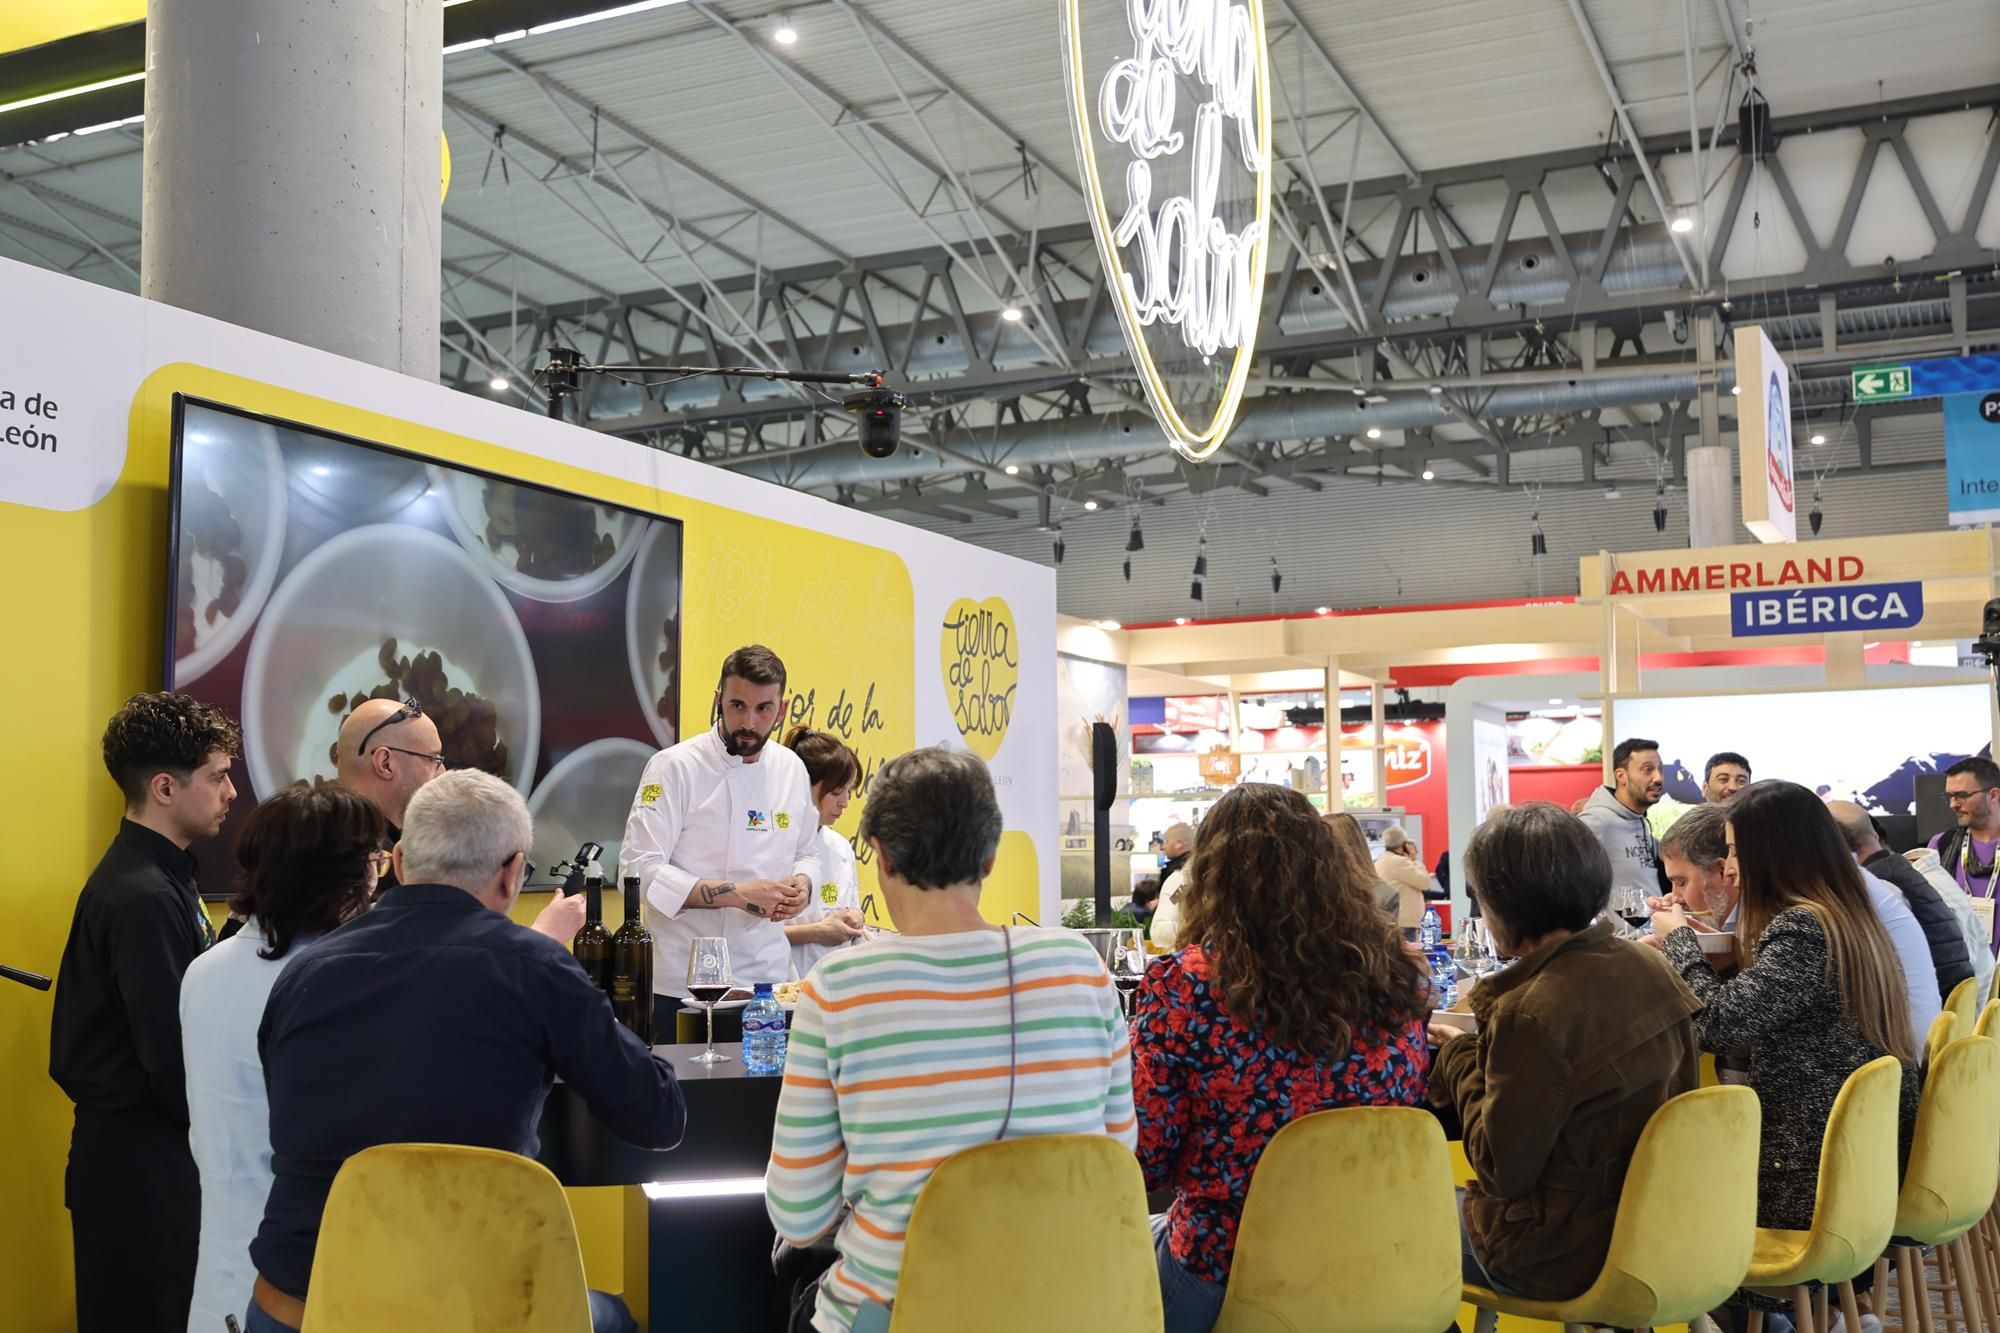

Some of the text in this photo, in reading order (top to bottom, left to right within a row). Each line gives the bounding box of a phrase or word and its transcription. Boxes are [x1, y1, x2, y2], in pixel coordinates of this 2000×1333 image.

[25, 392, 58, 420] de
[1985, 401, 2000, 417] P
[0, 423, 57, 452] eón
[1960, 478, 2000, 495] Inte
[1609, 556, 1864, 595] AMMERLAND
[1745, 591, 1909, 626] IBÉRICA
[943, 608, 1017, 668] tierra
[949, 653, 974, 688] de
[827, 689, 852, 739] de
[862, 682, 884, 733] la
[955, 659, 1017, 736] sabor
